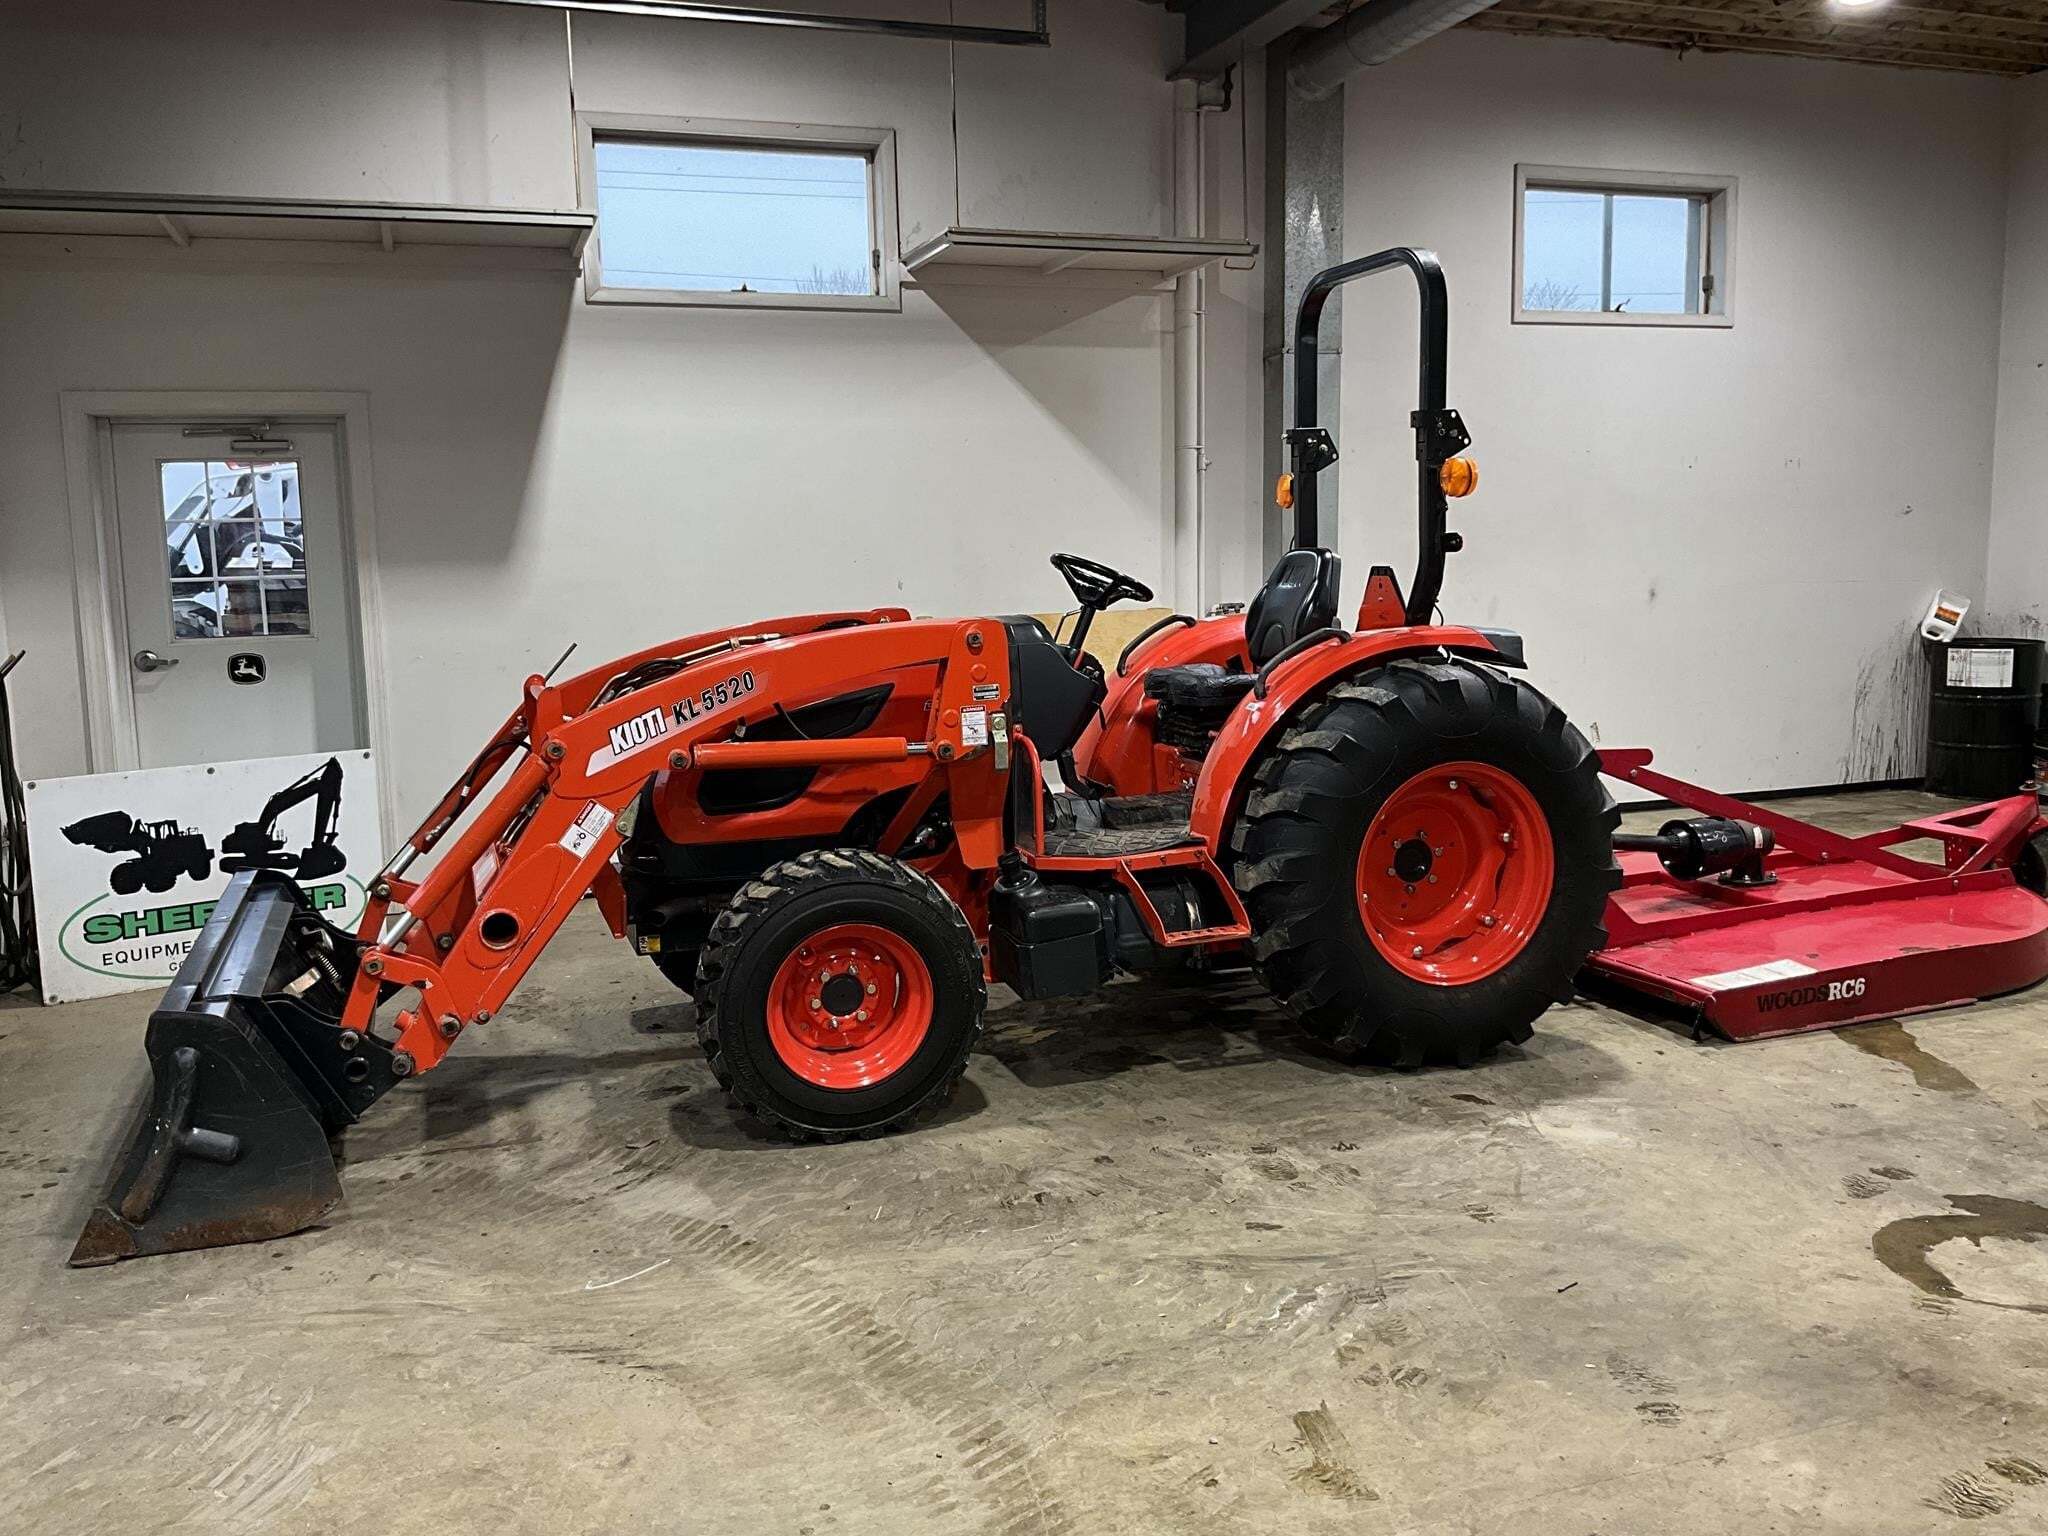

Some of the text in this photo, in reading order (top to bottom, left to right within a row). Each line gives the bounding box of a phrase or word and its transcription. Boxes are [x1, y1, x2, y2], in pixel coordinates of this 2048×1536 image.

[608, 671, 756, 756] KIOTI KL 5520
[102, 941, 192, 966] EQUIPME
